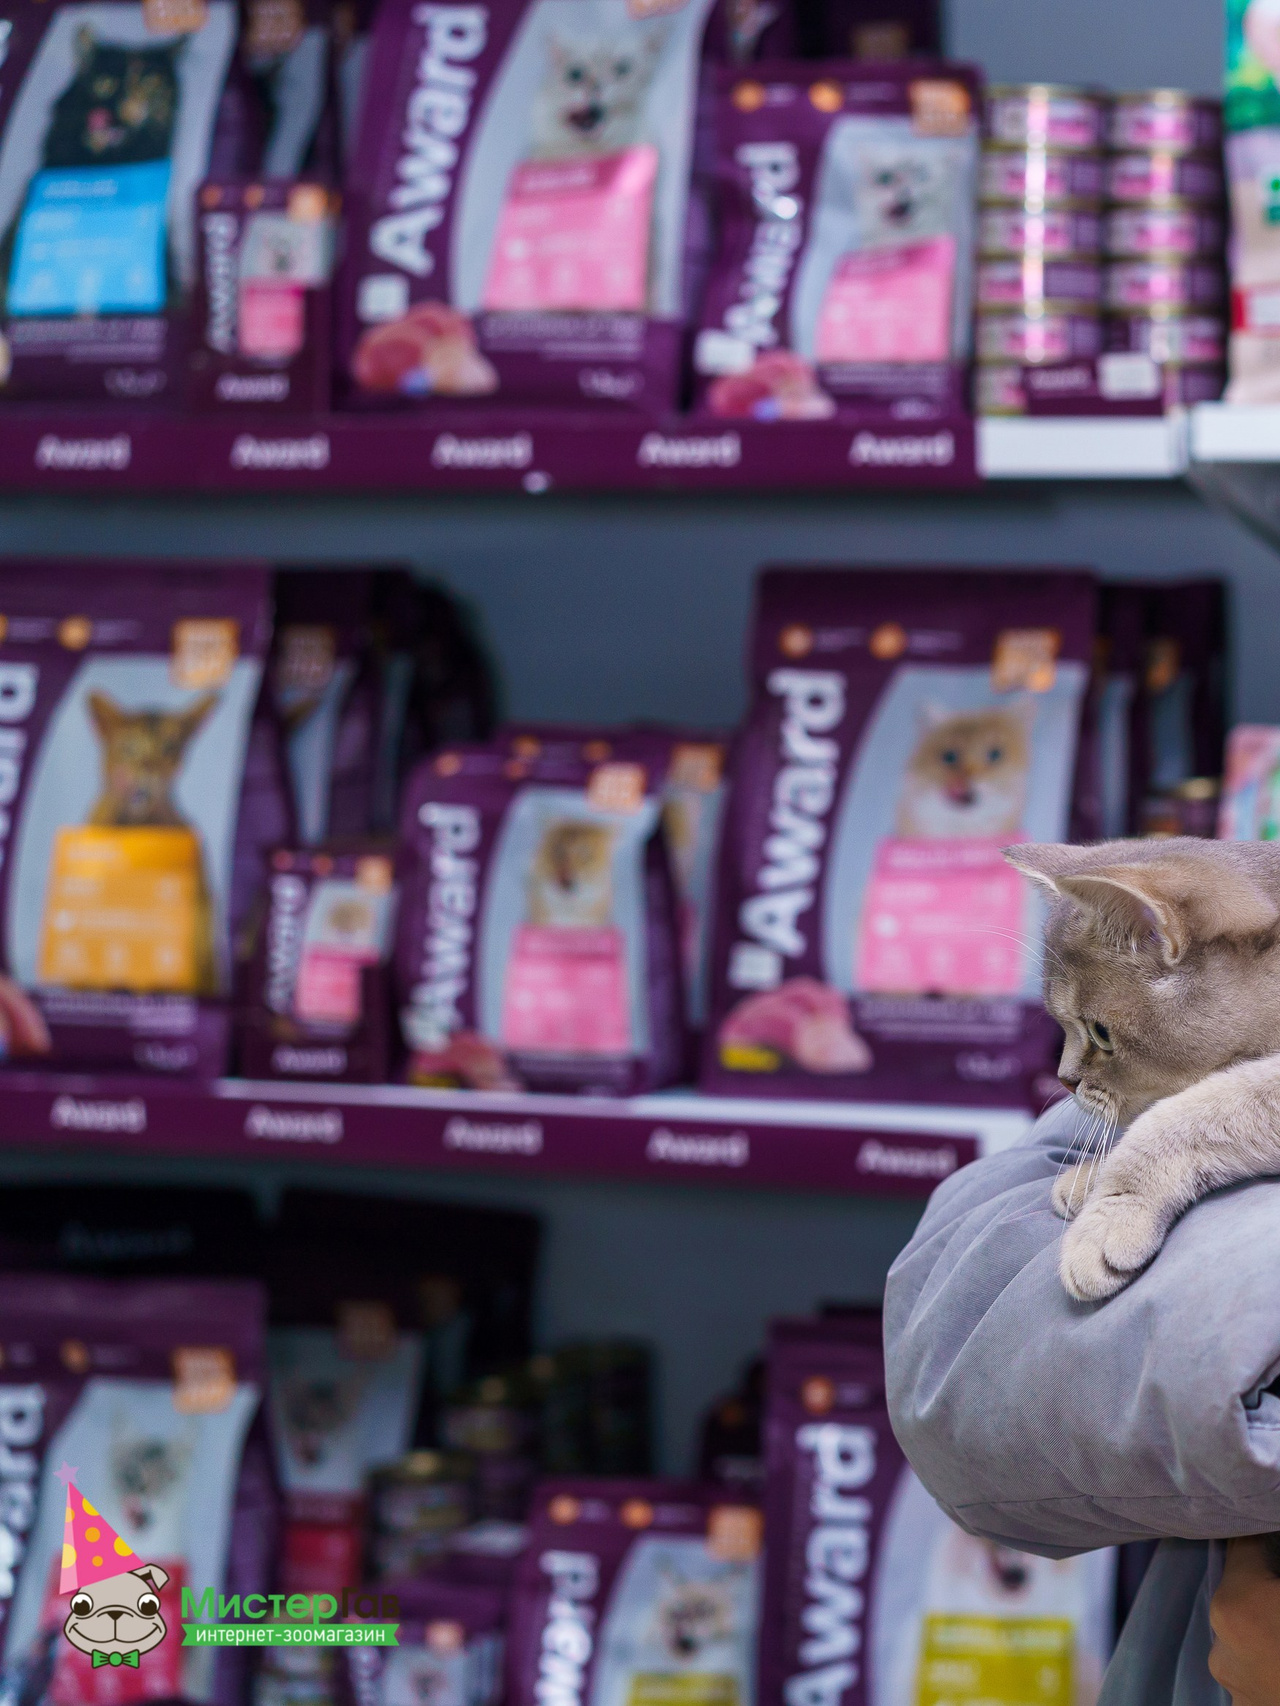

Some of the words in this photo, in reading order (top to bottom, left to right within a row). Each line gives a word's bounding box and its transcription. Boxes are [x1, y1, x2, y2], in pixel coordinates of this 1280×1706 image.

[371, 4, 488, 275] Award
[723, 141, 798, 348] Award
[36, 432, 131, 470] Award
[231, 433, 330, 469] Award
[432, 432, 534, 469] Award
[638, 430, 741, 468] Award
[849, 430, 954, 467] Award
[742, 668, 847, 958] Award
[51, 1096, 147, 1134] Award
[245, 1105, 343, 1144] Award
[444, 1116, 542, 1155] Award
[648, 1128, 749, 1166] Award
[857, 1139, 957, 1177] Award
